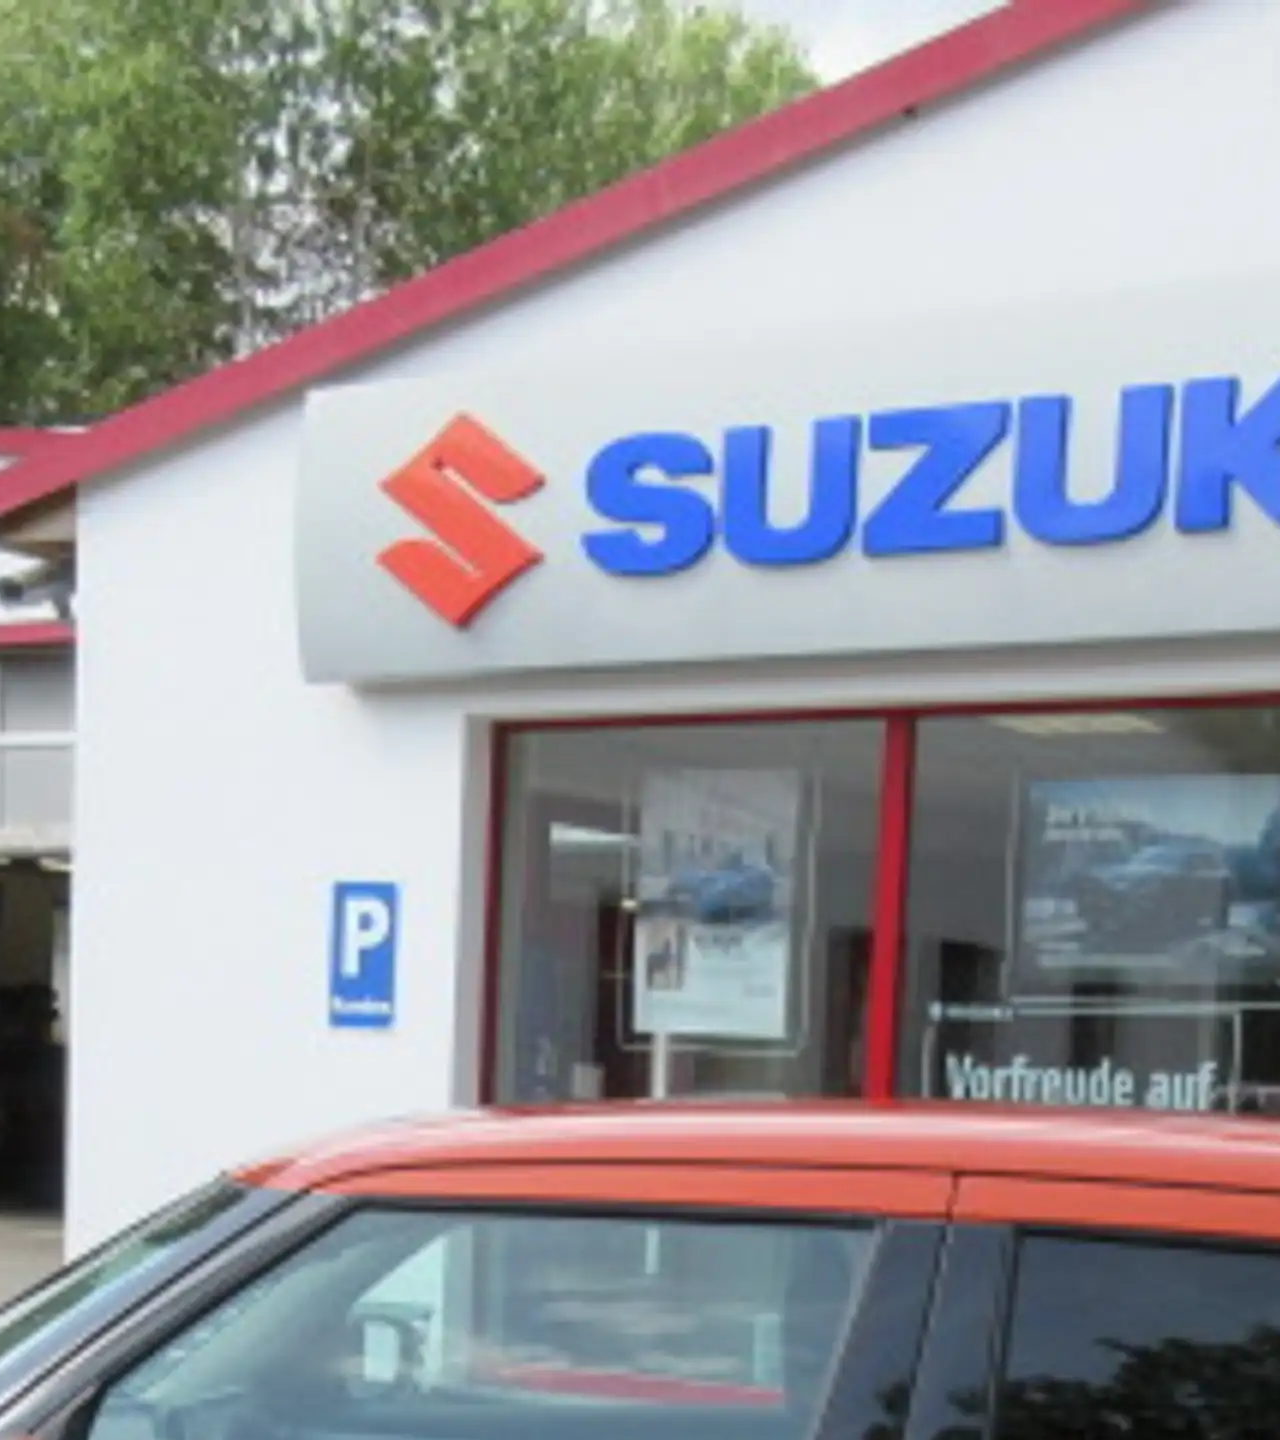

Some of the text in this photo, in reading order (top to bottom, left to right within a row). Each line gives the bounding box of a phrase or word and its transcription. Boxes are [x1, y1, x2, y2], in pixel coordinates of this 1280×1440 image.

[341, 896, 390, 978] P
[945, 1052, 1218, 1111] Vorfreude auf
